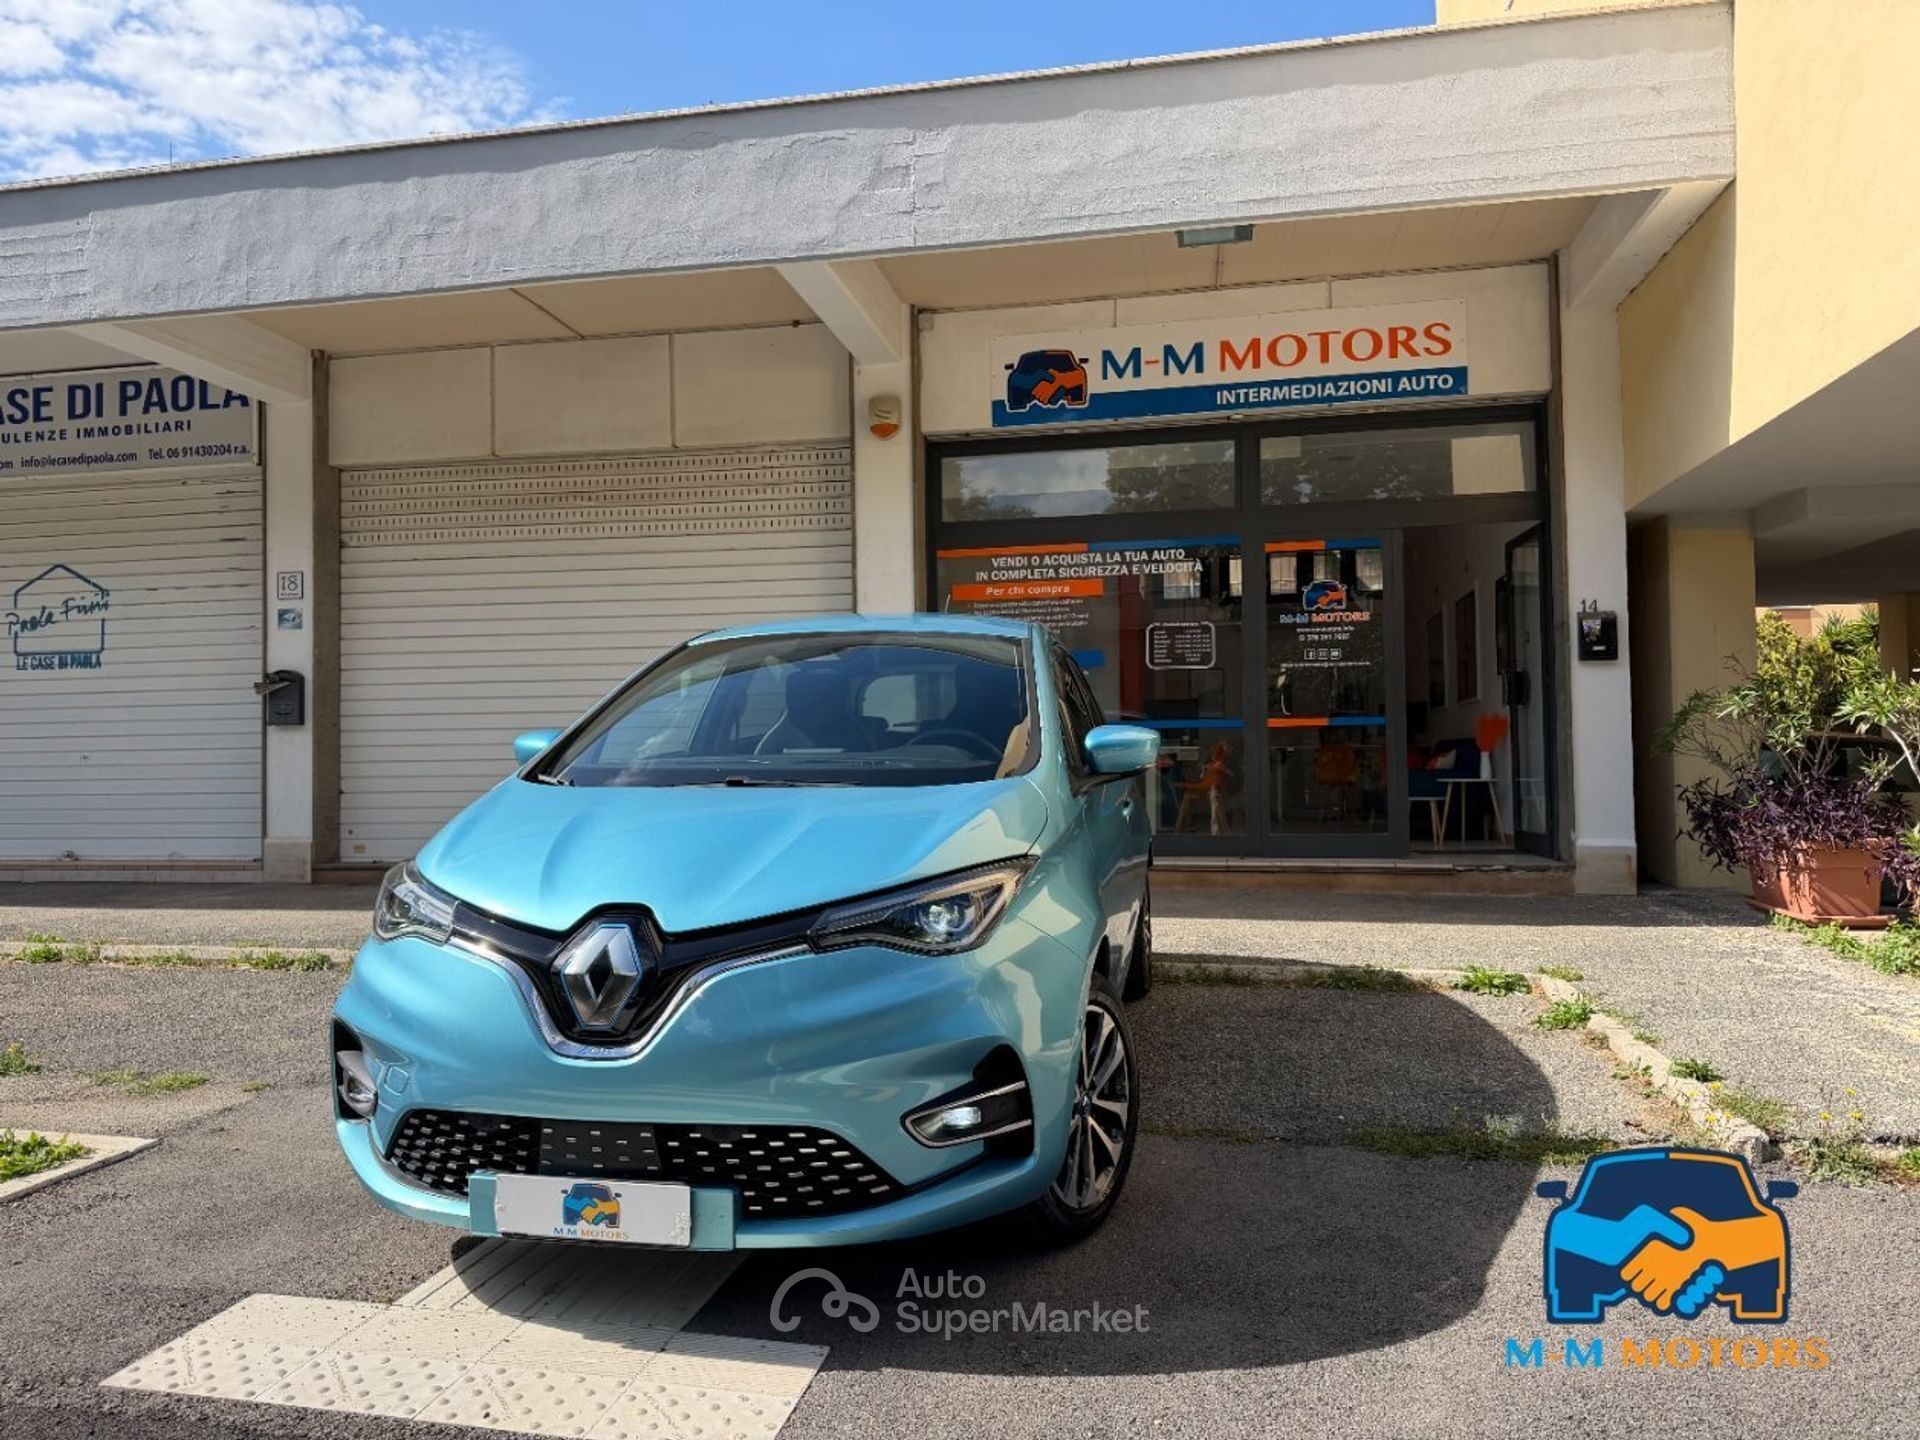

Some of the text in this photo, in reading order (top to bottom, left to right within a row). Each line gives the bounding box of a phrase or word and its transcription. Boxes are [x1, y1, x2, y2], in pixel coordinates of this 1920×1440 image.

[1101, 322, 1453, 381] M-M MOTORS
[1216, 373, 1454, 405] INTERMEDIAZIONI AUTO
[0, 374, 250, 425] SE DI PAOLA
[1, 419, 192, 444] ULENZE IMMOBILIARI
[21, 452, 138, 468] info@lecasedipaola.com
[148, 448, 166, 460] Tel.
[166, 447, 180, 459] 06
[181, 444, 232, 458] 91430204
[991, 548, 1186, 568] VENDI O ACQUISTA LA TUA AUTO
[975, 558, 1204, 582] IN COMPLETA SICUREZZA E VELOCITÀ
[281, 575, 298, 591] 18
[985, 584, 1070, 596] Per chi compra
[1580, 598, 1598, 613] 14
[1311, 611, 1371, 622] MOTORS
[16, 656, 28, 670] LE
[31, 656, 56, 670] CASE
[581, 1228, 630, 1240] MOTORS
